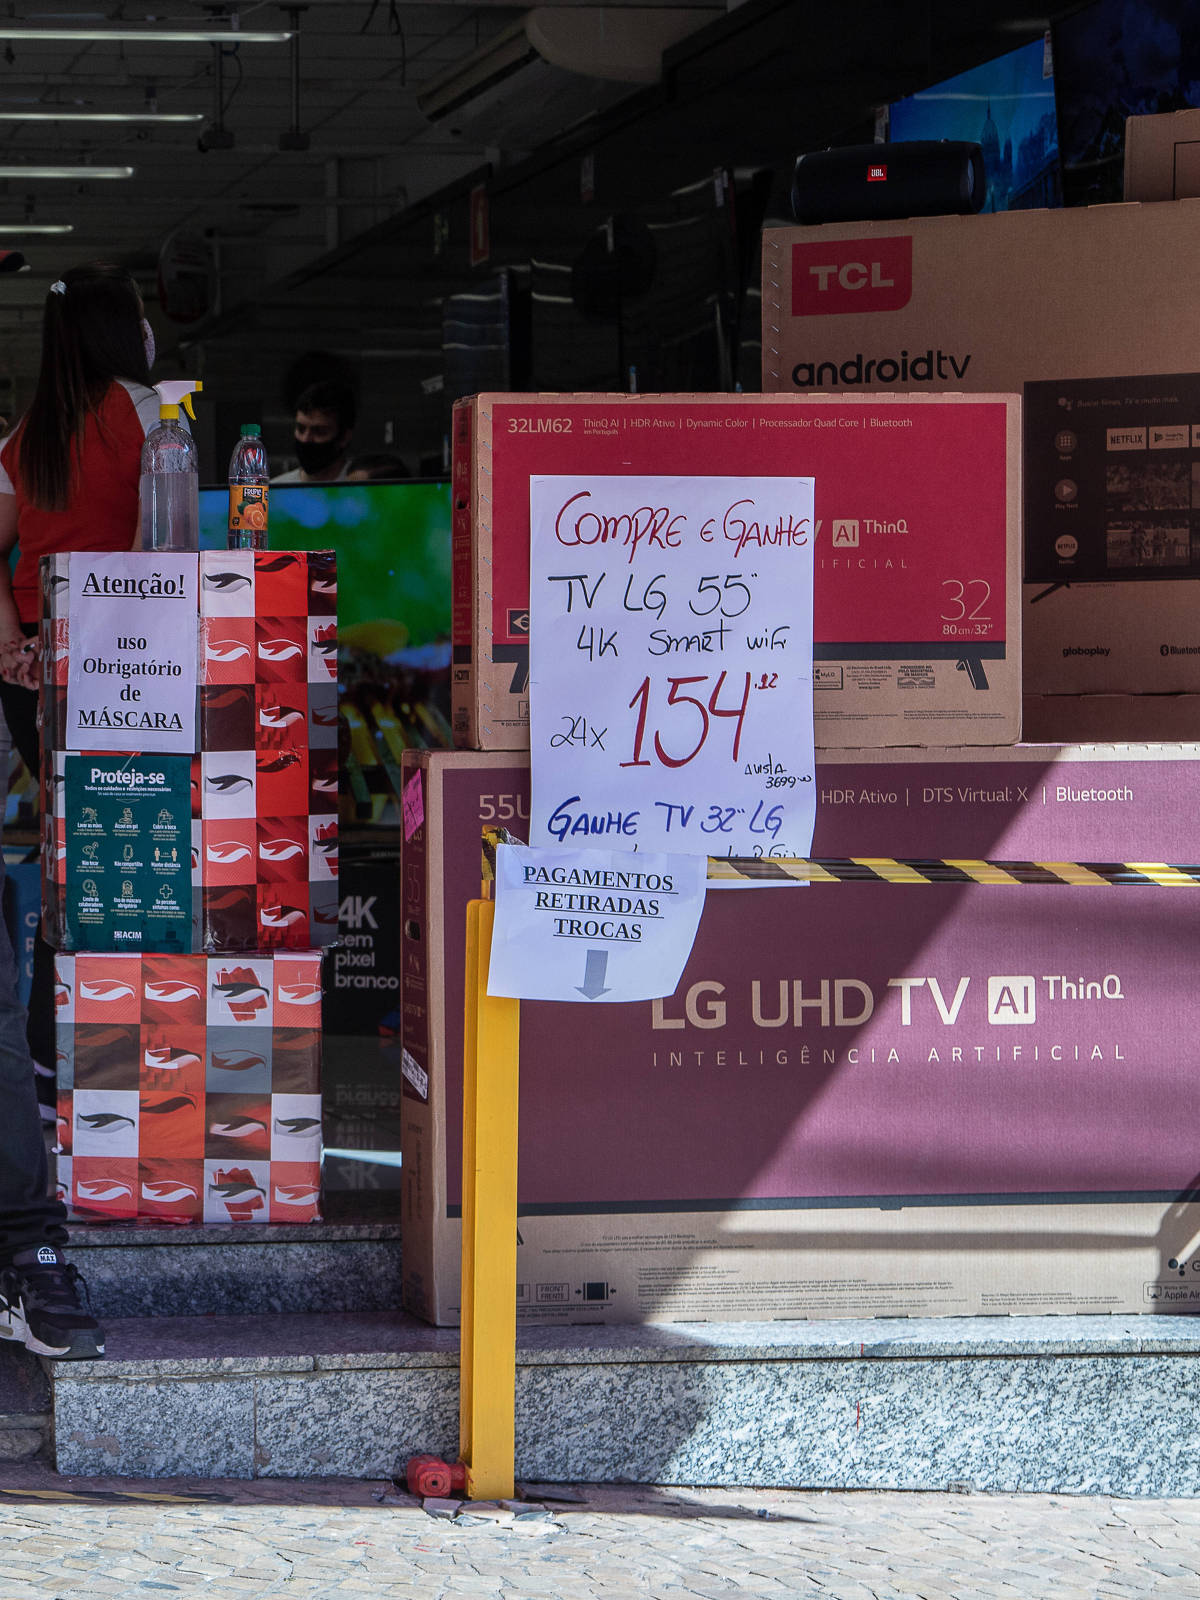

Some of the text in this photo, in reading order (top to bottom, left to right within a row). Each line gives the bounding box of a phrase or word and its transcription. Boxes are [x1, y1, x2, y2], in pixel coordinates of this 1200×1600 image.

[871, 168, 884, 177] JBL
[809, 262, 894, 291] TCL
[507, 418, 913, 433] 32LM62 ThinQ AI HDR Ativo Dynamic Color Processador Quad Core Bluetooth
[1110, 434, 1143, 445] NETFLIX
[835, 519, 909, 542] AI ThinQ
[821, 559, 908, 568] IFICIAL
[82, 572, 185, 600] Atenção!
[547, 572, 606, 613] TV
[623, 573, 667, 620] LG
[940, 579, 992, 621] 32
[117, 636, 147, 650] uso
[577, 624, 619, 662] 4K
[1062, 646, 1111, 658] globoplay
[83, 658, 182, 679] Obrigatório
[120, 684, 141, 701] de
[78, 706, 183, 729] MÁSCARA
[91, 768, 165, 787] Proteja-se
[821, 785, 1133, 804] HDR Ativo DTS Virtual: X Bluetooth
[547, 795, 640, 842] GANHE
[655, 801, 695, 832] TV
[749, 800, 784, 839] LG
[523, 865, 673, 891] PAGAMENTOS
[338, 896, 379, 929] 4K
[535, 891, 659, 915] RETIRADAS
[122, 931, 142, 939] ACIM
[554, 918, 641, 939] TROCAS
[339, 934, 373, 948] sem
[335, 950, 375, 970] pixel
[335, 972, 399, 989] branco
[651, 974, 1125, 1030] LG UHD TV AI ThinQ
[653, 1044, 1125, 1067] INTELIGÊNCIA ARTIFICIAL
[1164, 1292, 1190, 1301] Apple
